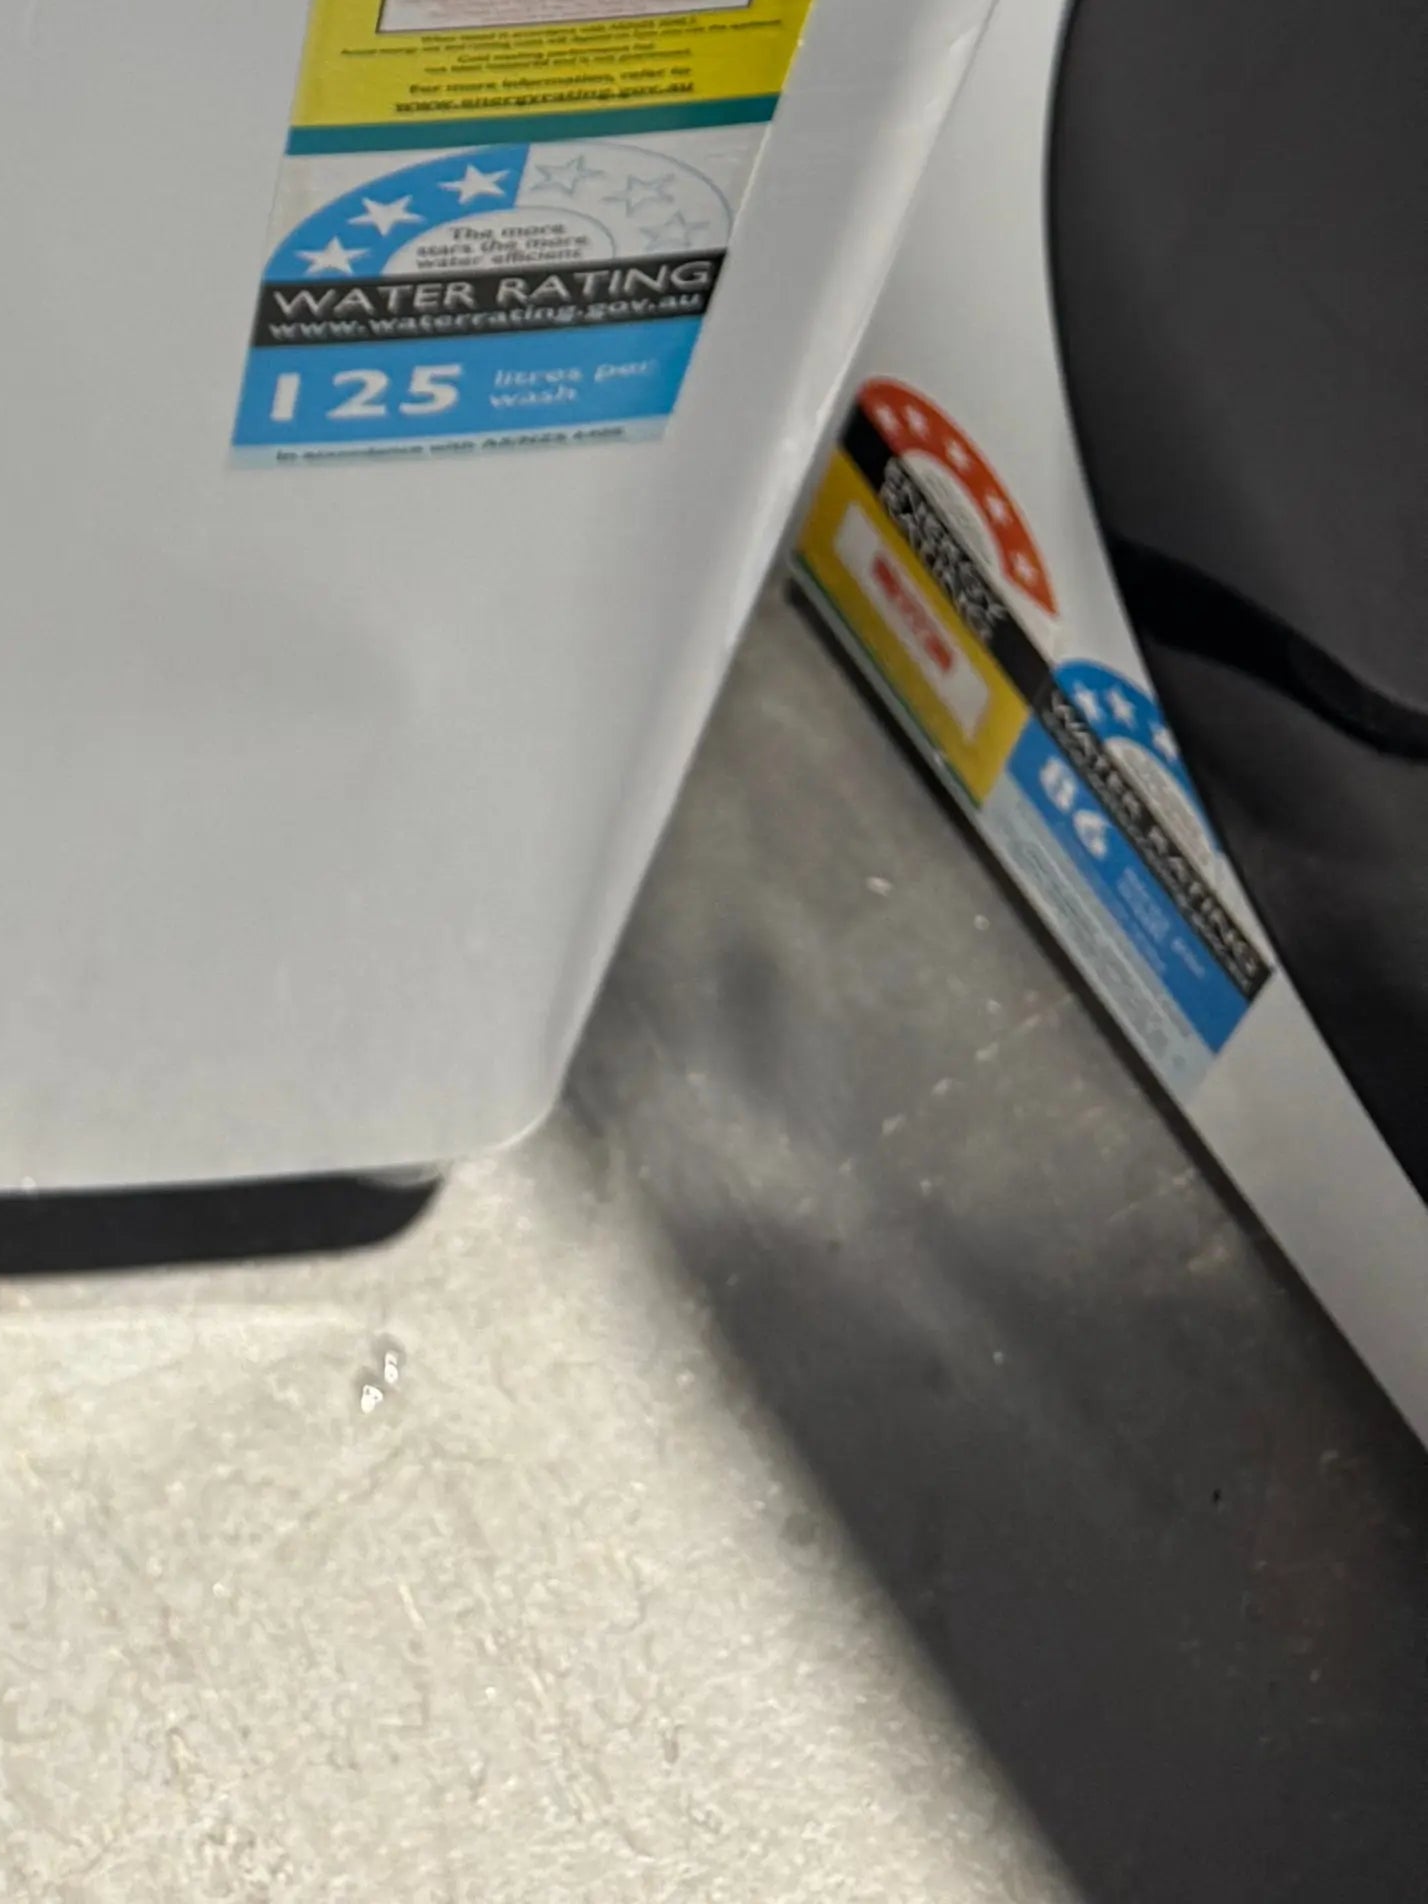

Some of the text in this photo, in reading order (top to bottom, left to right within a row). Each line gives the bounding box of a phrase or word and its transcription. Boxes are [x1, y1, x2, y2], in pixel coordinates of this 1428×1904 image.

[268, 292, 702, 341] www.waterrating.gov.au
[273, 259, 714, 322] WATER RATING
[269, 362, 464, 423] 125
[494, 366, 583, 388] litres
[488, 388, 579, 410] wash
